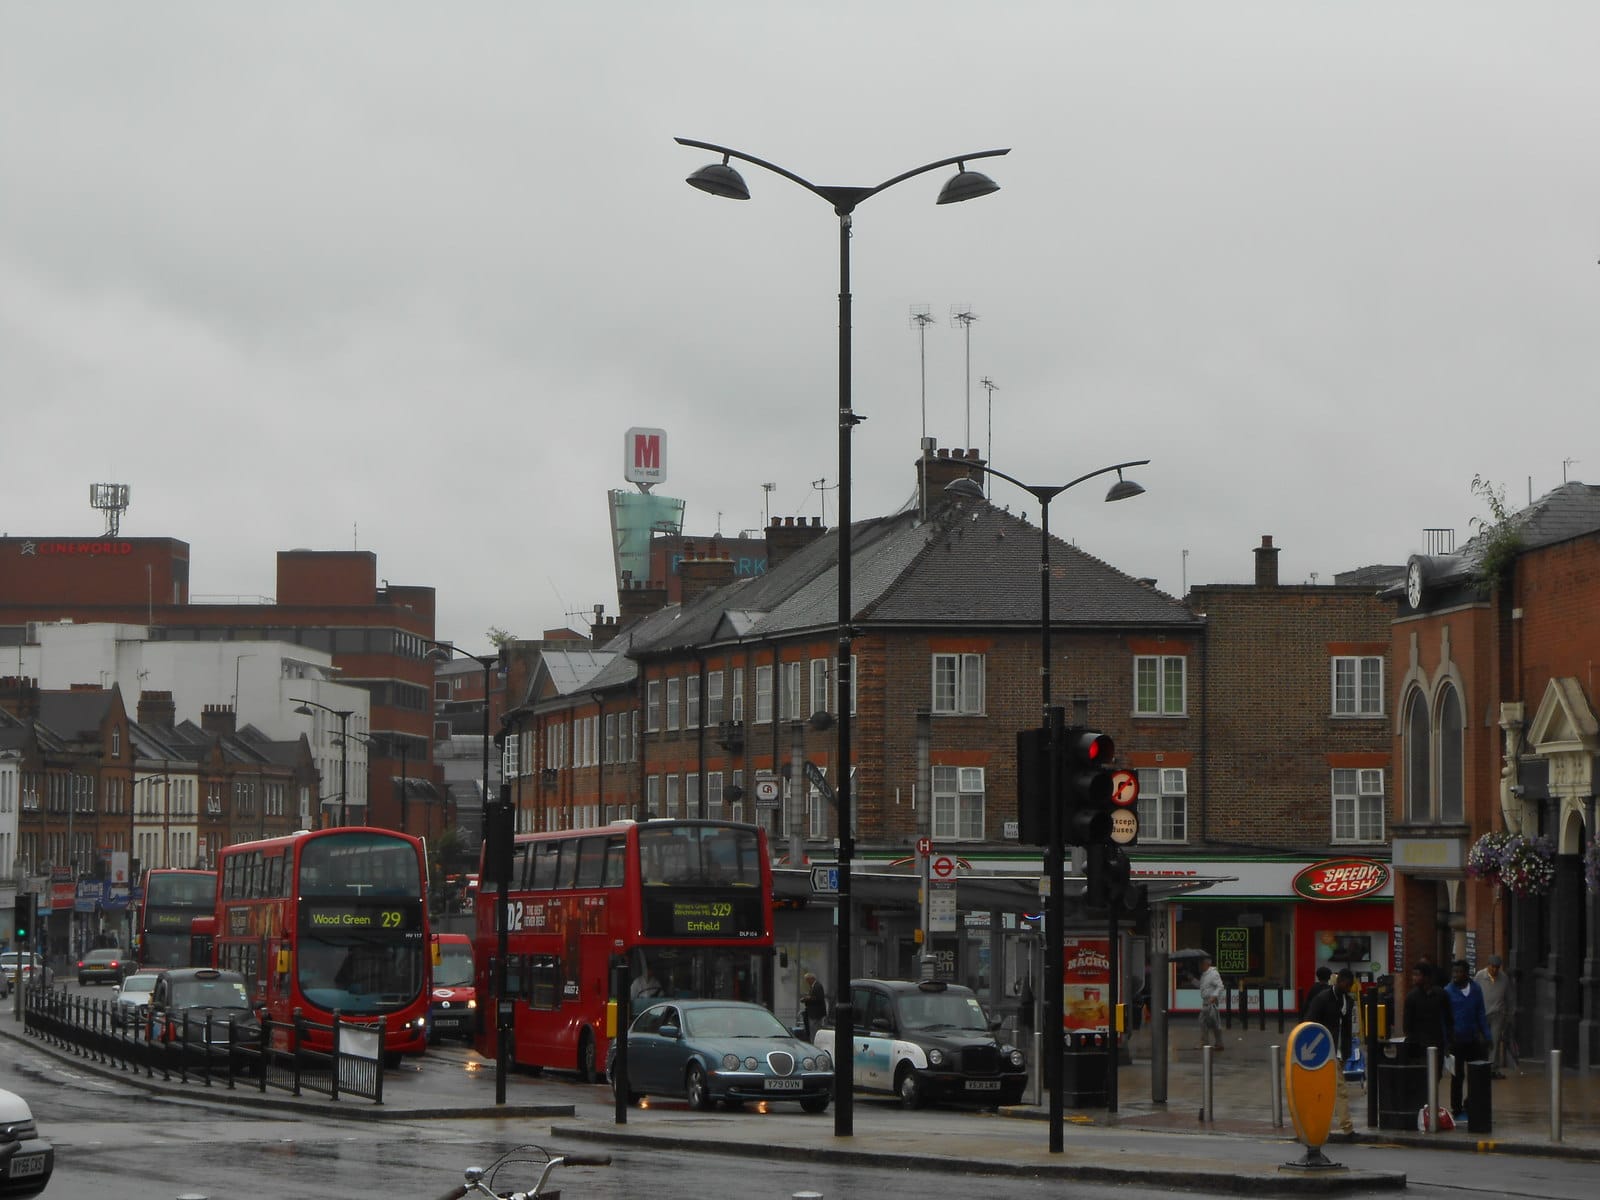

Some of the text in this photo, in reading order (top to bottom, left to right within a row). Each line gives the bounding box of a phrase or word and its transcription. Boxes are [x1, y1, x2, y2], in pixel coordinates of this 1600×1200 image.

[634, 434, 660, 468] M
[38, 542, 133, 555] CINEWORLD
[920, 840, 930, 852] H
[1324, 865, 1376, 883] SPEEDY
[1325, 879, 1372, 893] CASH
[711, 902, 733, 917] 329
[313, 911, 401, 928] Wood Green 29
[687, 921, 720, 931] Enfield
[1219, 930, 1246, 942] £200
[1220, 950, 1245, 961] FREE
[1220, 961, 1245, 970] LOAN
